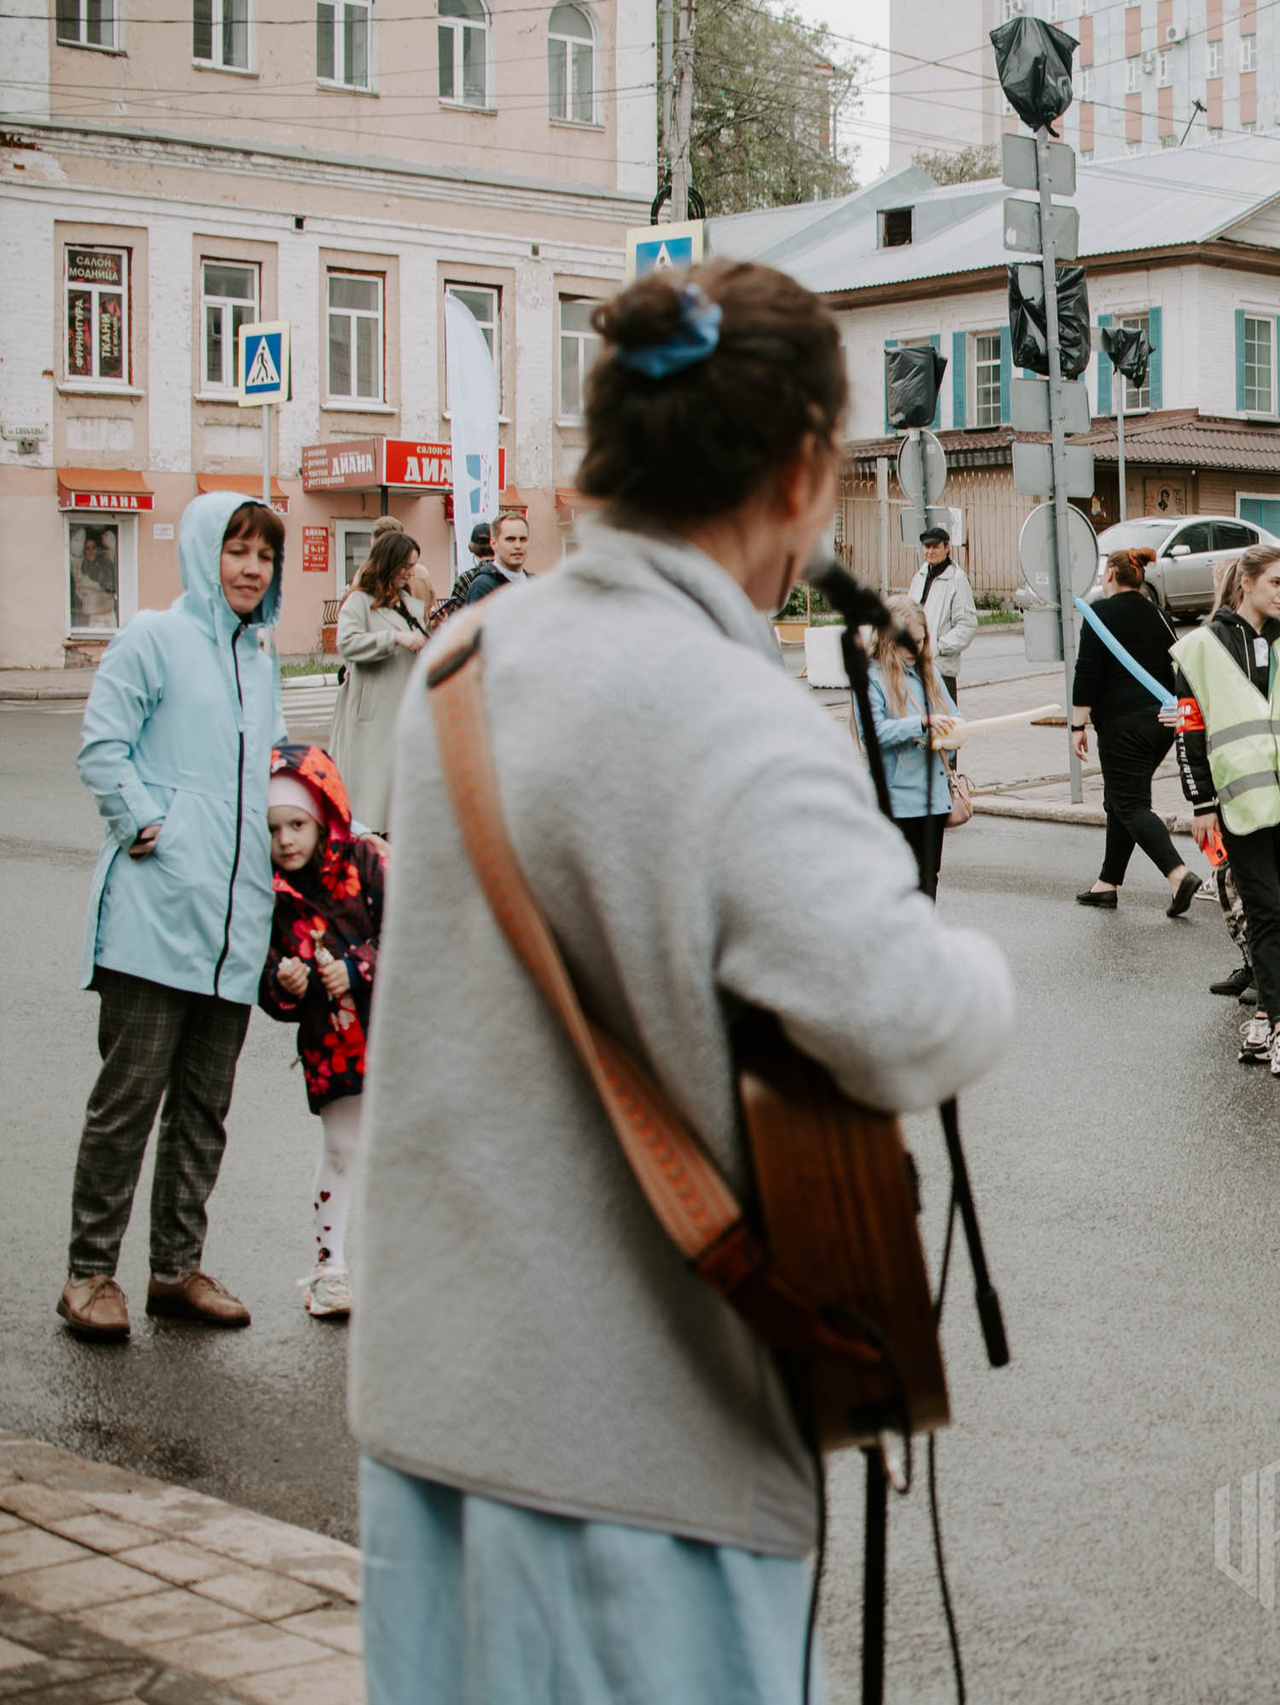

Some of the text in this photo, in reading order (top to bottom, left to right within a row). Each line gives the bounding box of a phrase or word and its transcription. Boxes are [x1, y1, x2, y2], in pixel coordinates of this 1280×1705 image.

[76, 255, 112, 267] САЛОН
[68, 267, 119, 281] МОДНИЦА
[75, 298, 84, 368] ФУРНИТУРА
[101, 313, 111, 358] ТКАНИ
[332, 453, 374, 477] ДИАНА
[404, 456, 453, 483] ДИА
[89, 494, 138, 508] ДИАНА
